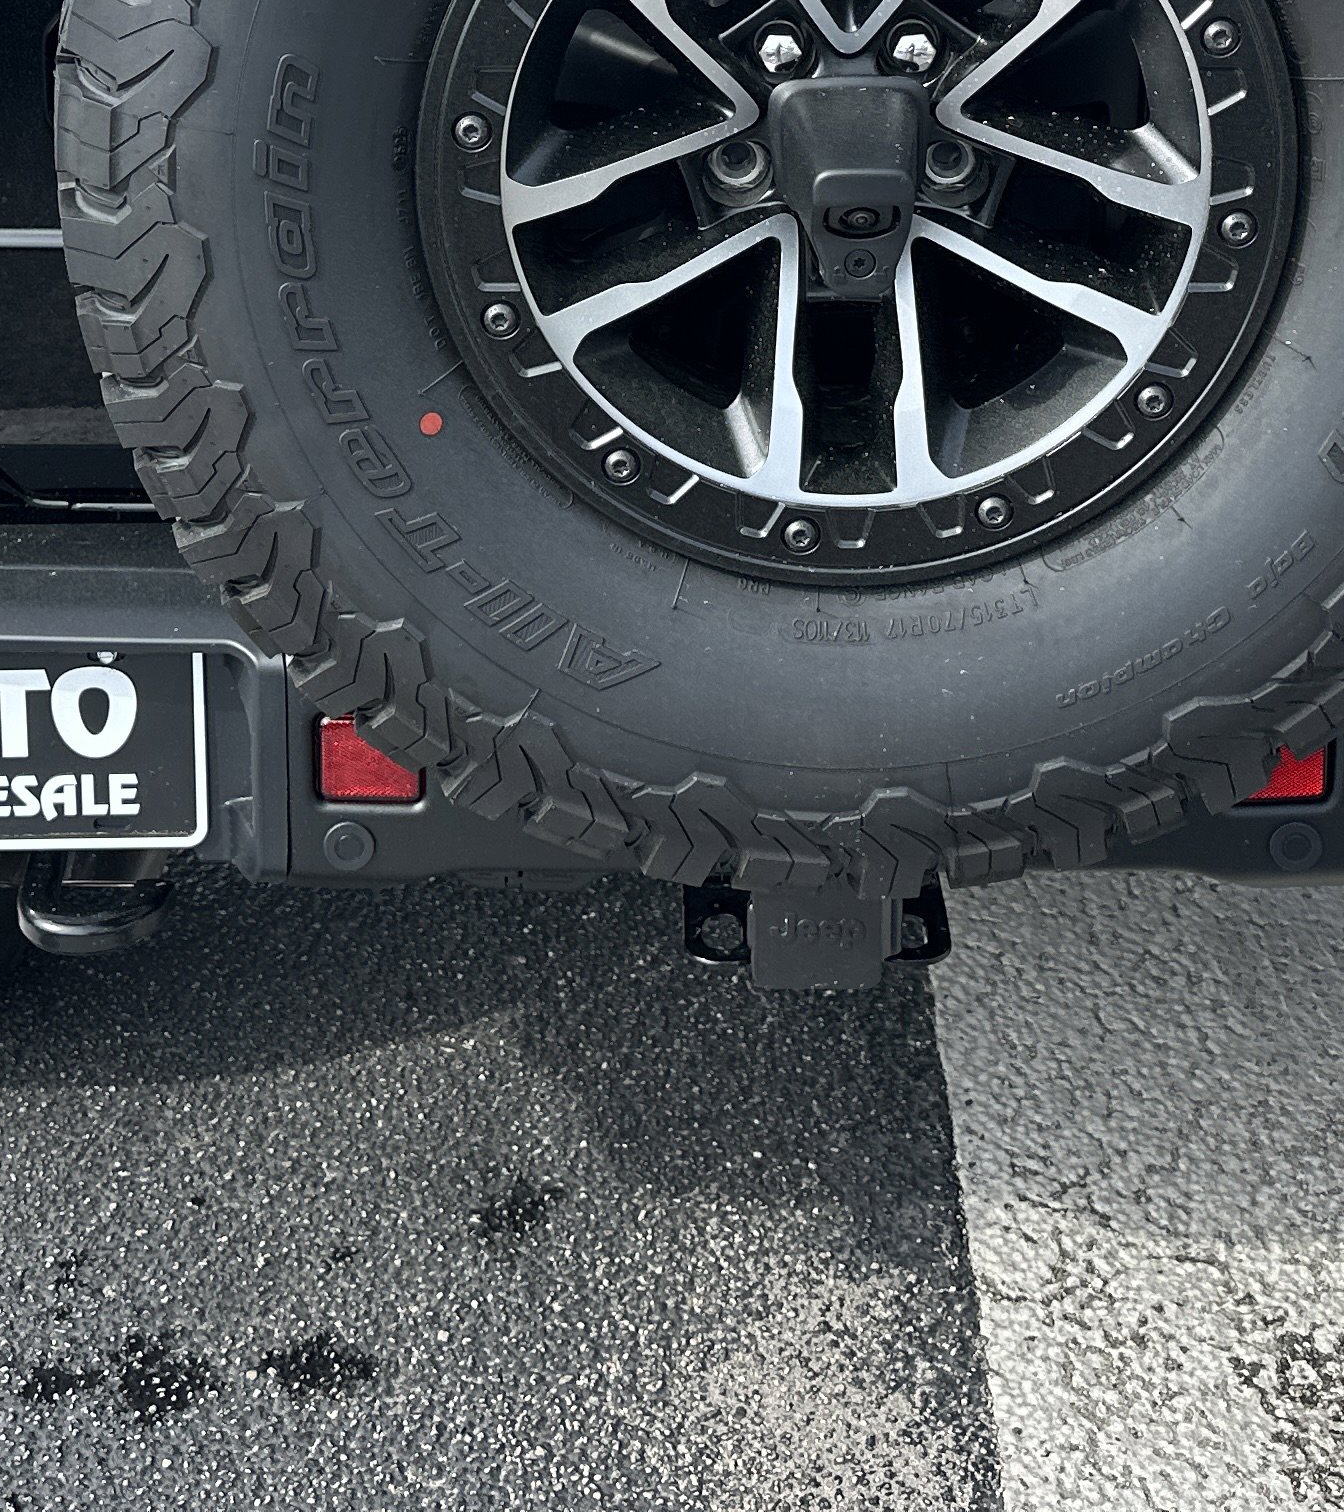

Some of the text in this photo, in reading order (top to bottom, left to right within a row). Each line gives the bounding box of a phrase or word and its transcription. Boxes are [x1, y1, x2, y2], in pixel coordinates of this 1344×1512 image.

[253, 53, 661, 690] All-Terrain
[1055, 605, 1232, 709] Champion
[768, 911, 866, 951] Jeep
